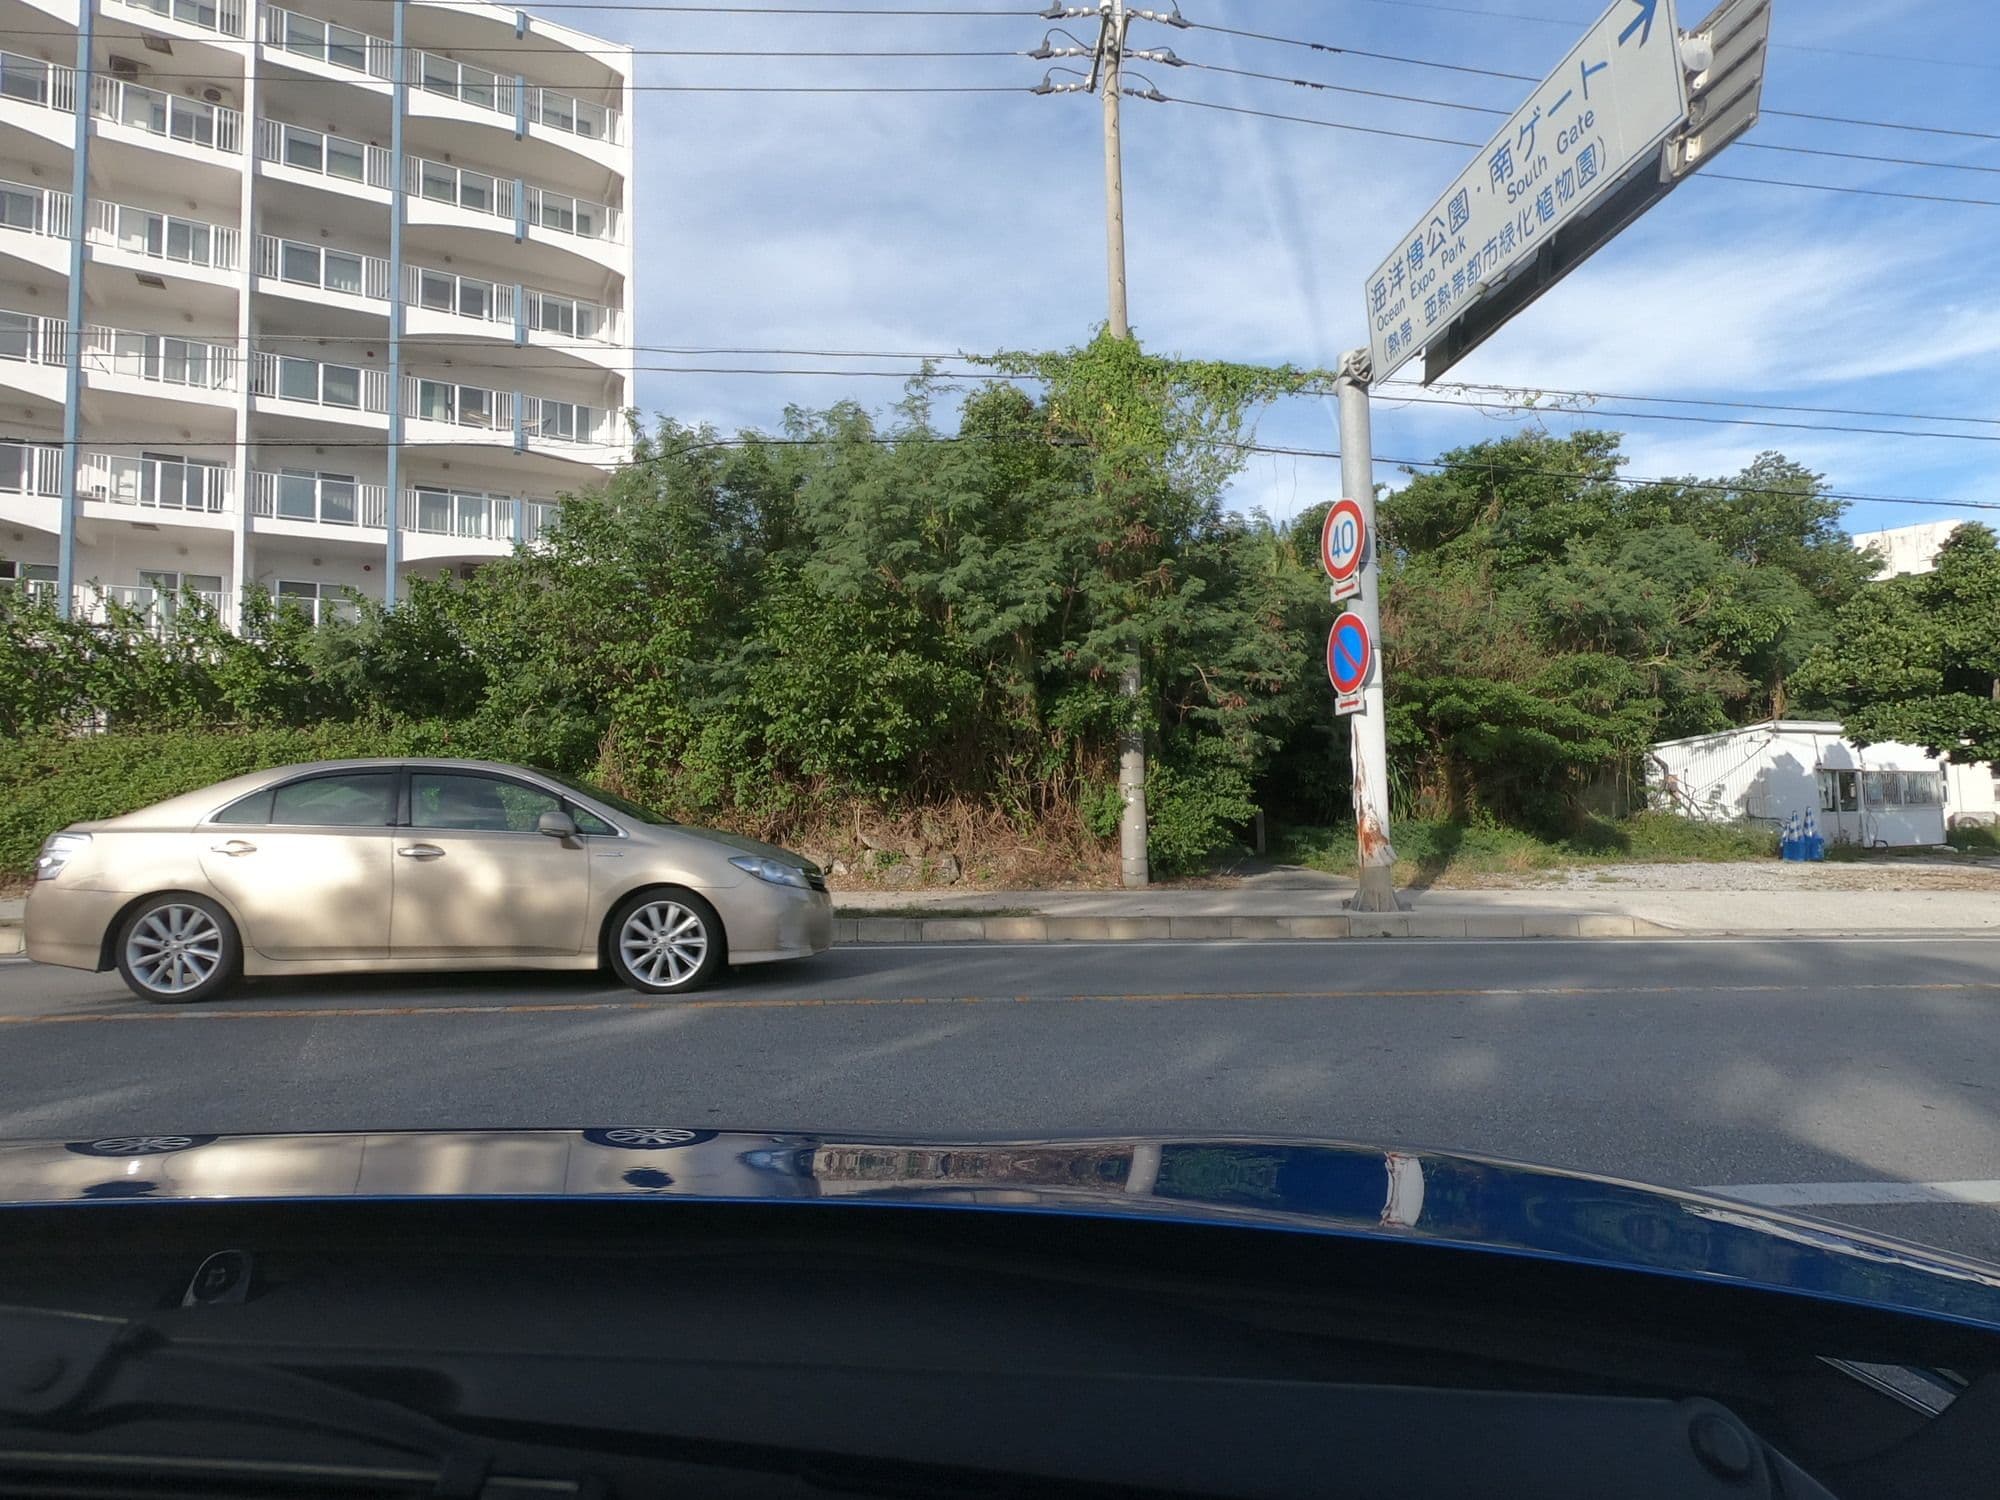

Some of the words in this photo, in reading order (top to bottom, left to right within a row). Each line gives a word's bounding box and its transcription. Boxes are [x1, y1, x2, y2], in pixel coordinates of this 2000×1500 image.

[1377, 297, 1406, 332] Ocean
[1410, 268, 1436, 301] Expo
[1441, 235, 1467, 270] Park
[1506, 155, 1548, 204] South
[1557, 109, 1595, 154] Gate
[1331, 520, 1354, 558] 40
